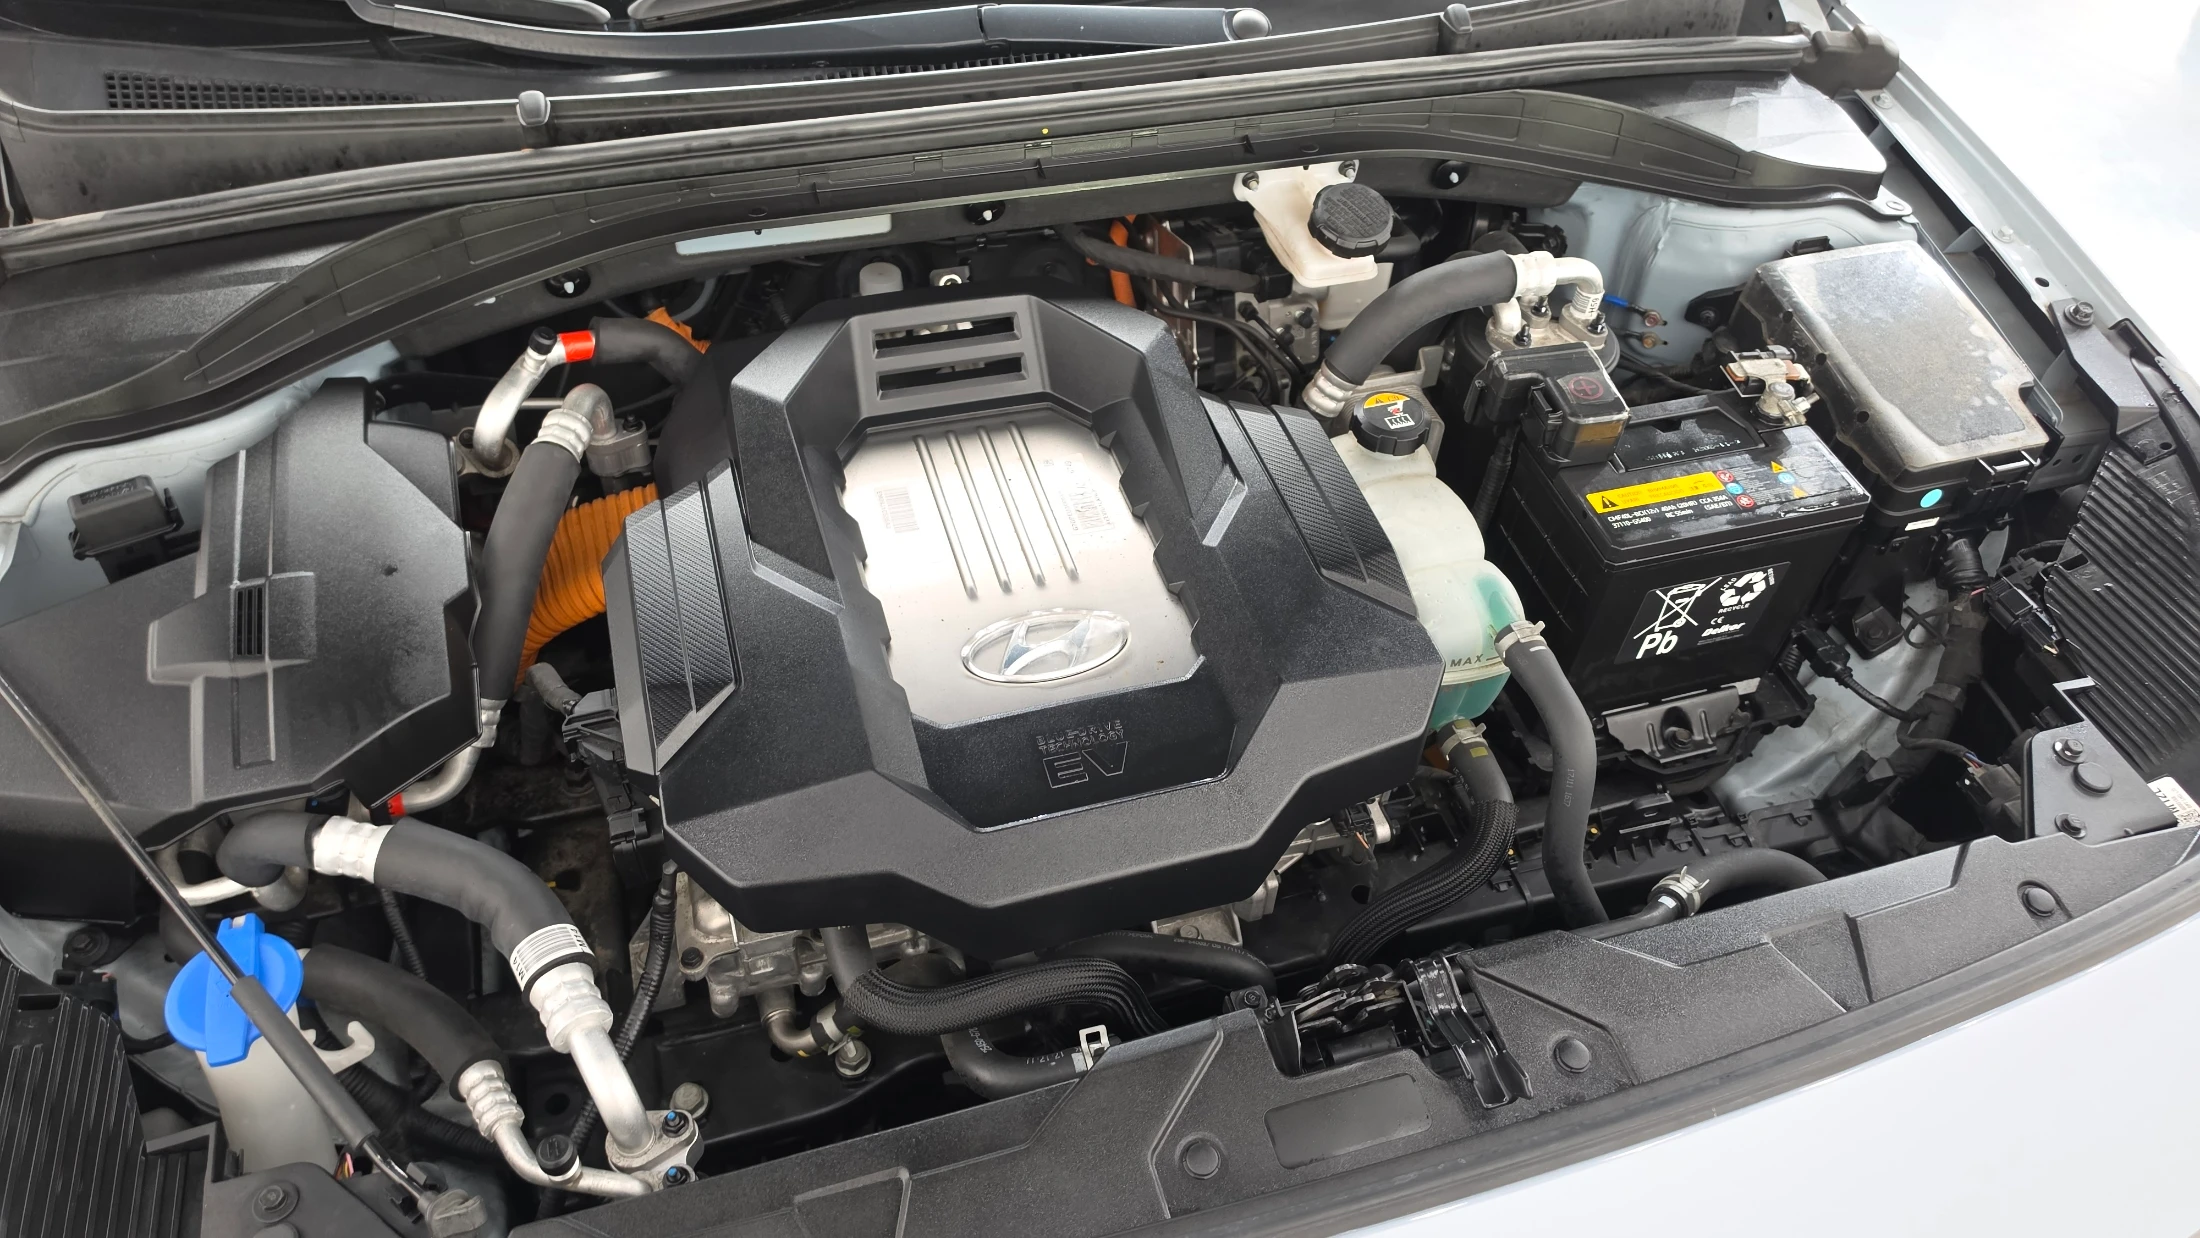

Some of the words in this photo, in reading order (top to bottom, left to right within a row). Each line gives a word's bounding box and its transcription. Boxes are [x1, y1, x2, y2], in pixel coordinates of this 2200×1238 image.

[1699, 496, 1713, 505] CCA
[1665, 510, 1675, 519] RC
[1720, 577, 1738, 591] LEAD
[1718, 602, 1751, 614] RECYCLE
[1636, 630, 1679, 660] Pb
[1450, 653, 1484, 668] MAX
[1042, 740, 1129, 789] EV
